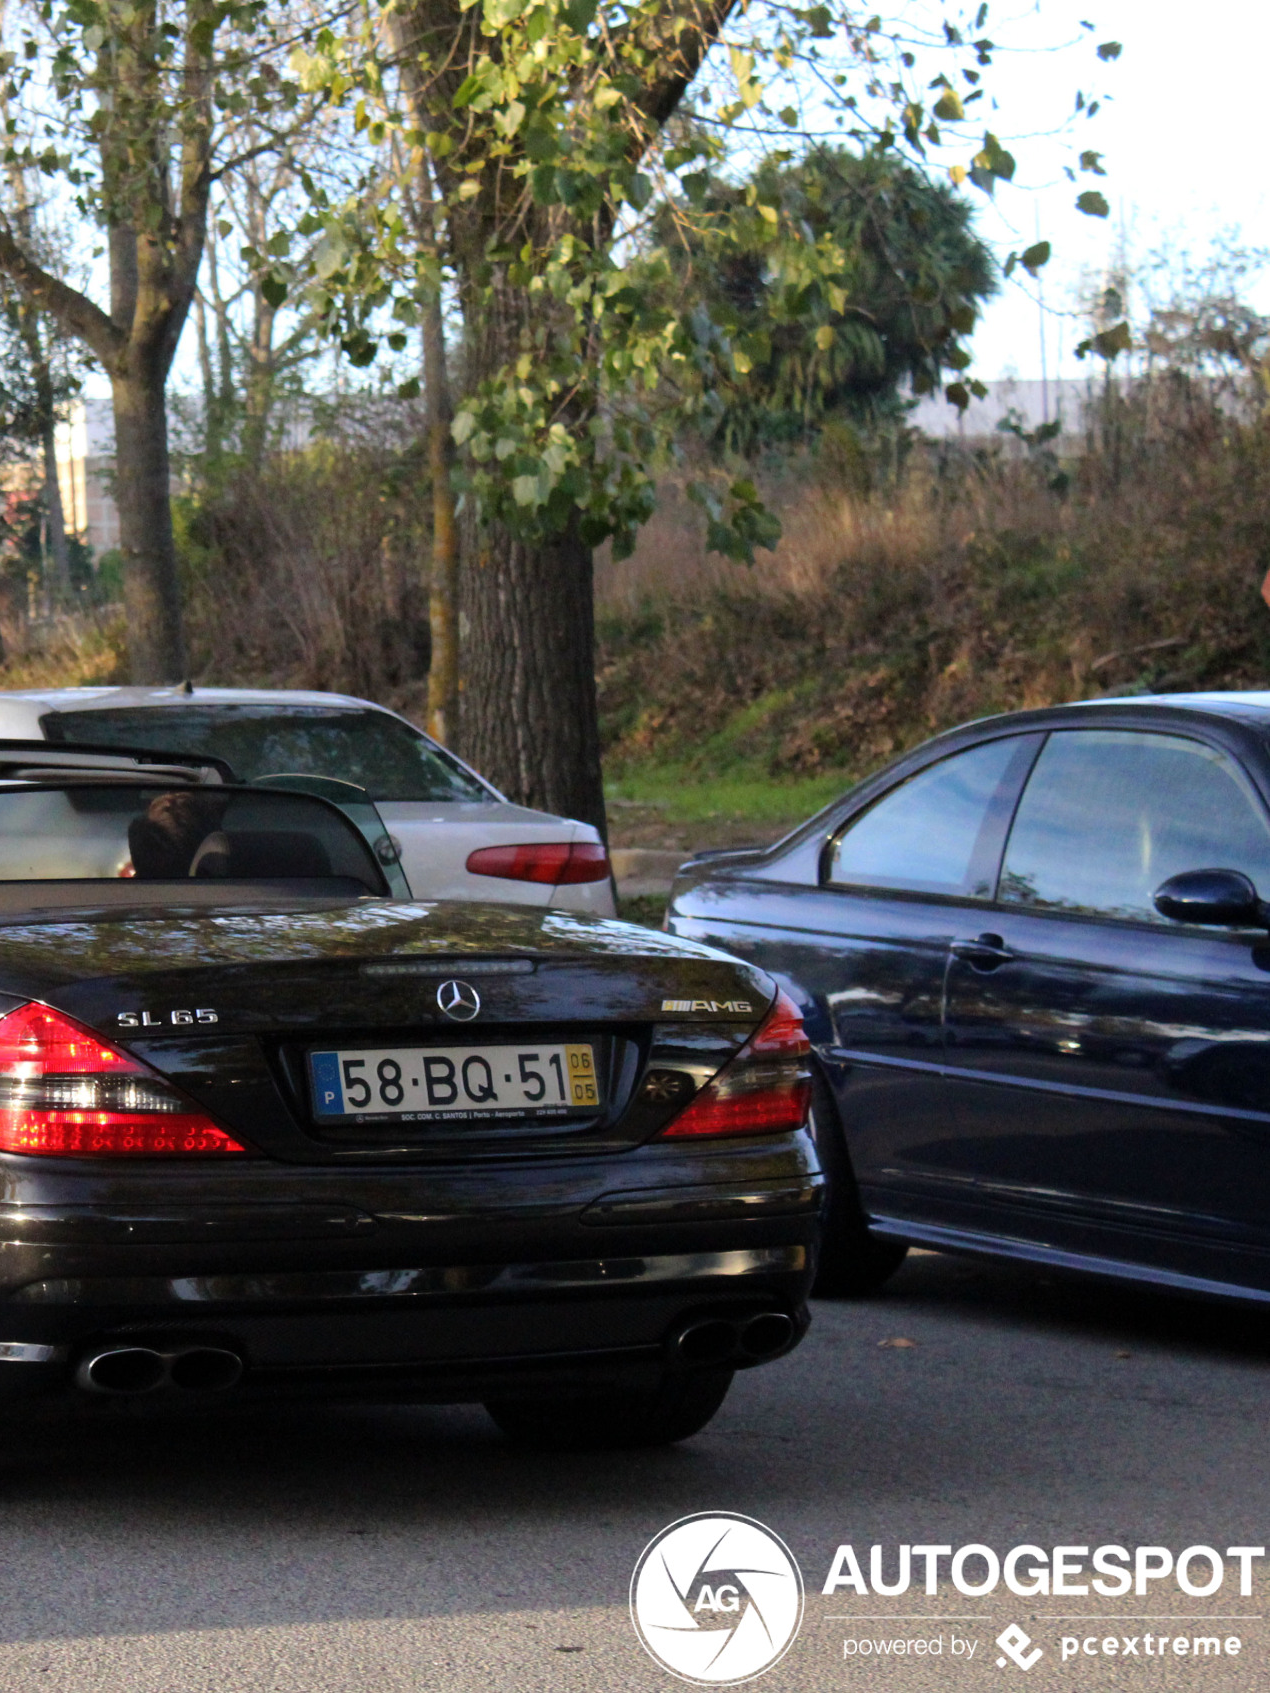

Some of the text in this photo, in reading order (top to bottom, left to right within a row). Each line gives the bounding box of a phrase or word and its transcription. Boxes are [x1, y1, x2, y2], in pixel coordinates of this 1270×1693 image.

[691, 1000, 752, 1012] AMG
[117, 1009, 219, 1027] SL 65
[571, 1053, 590, 1069] 06
[324, 1091, 335, 1105] P
[575, 1084, 595, 1099] 05
[442, 1112, 468, 1120] SANTOS
